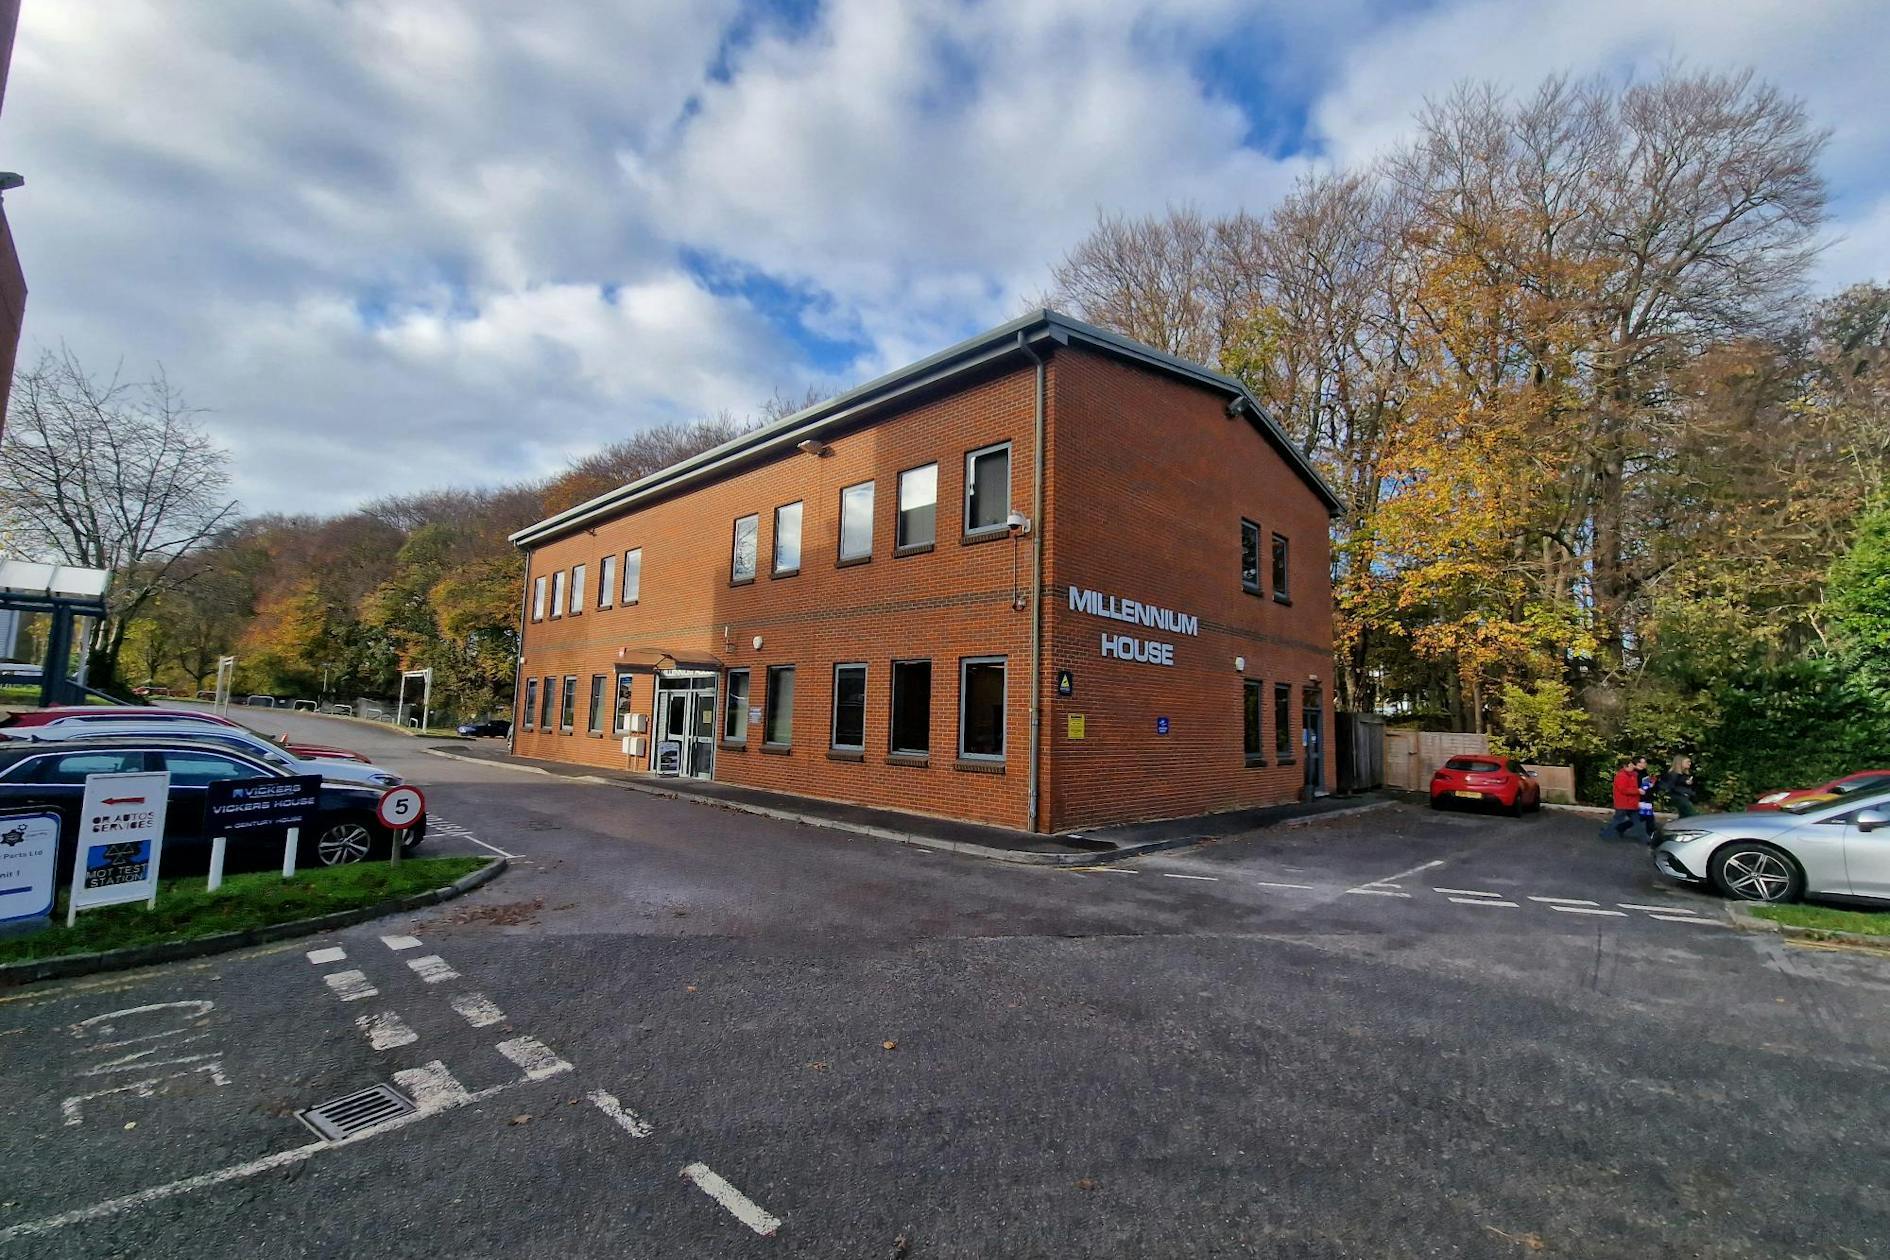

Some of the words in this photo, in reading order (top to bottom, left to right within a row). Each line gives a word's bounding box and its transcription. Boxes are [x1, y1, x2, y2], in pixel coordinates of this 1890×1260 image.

[1068, 585, 1199, 637] MILLENNIUM
[1101, 632, 1175, 666] HOUSE
[244, 784, 302, 796] VICKERS
[213, 801, 271, 814] VICKERS
[273, 797, 316, 808] HOUSE
[395, 798, 409, 815] 5
[92, 820, 154, 833] SERVICES
[86, 867, 114, 879] MOT
[117, 863, 148, 875] TEST
[90, 873, 144, 888] STATION
